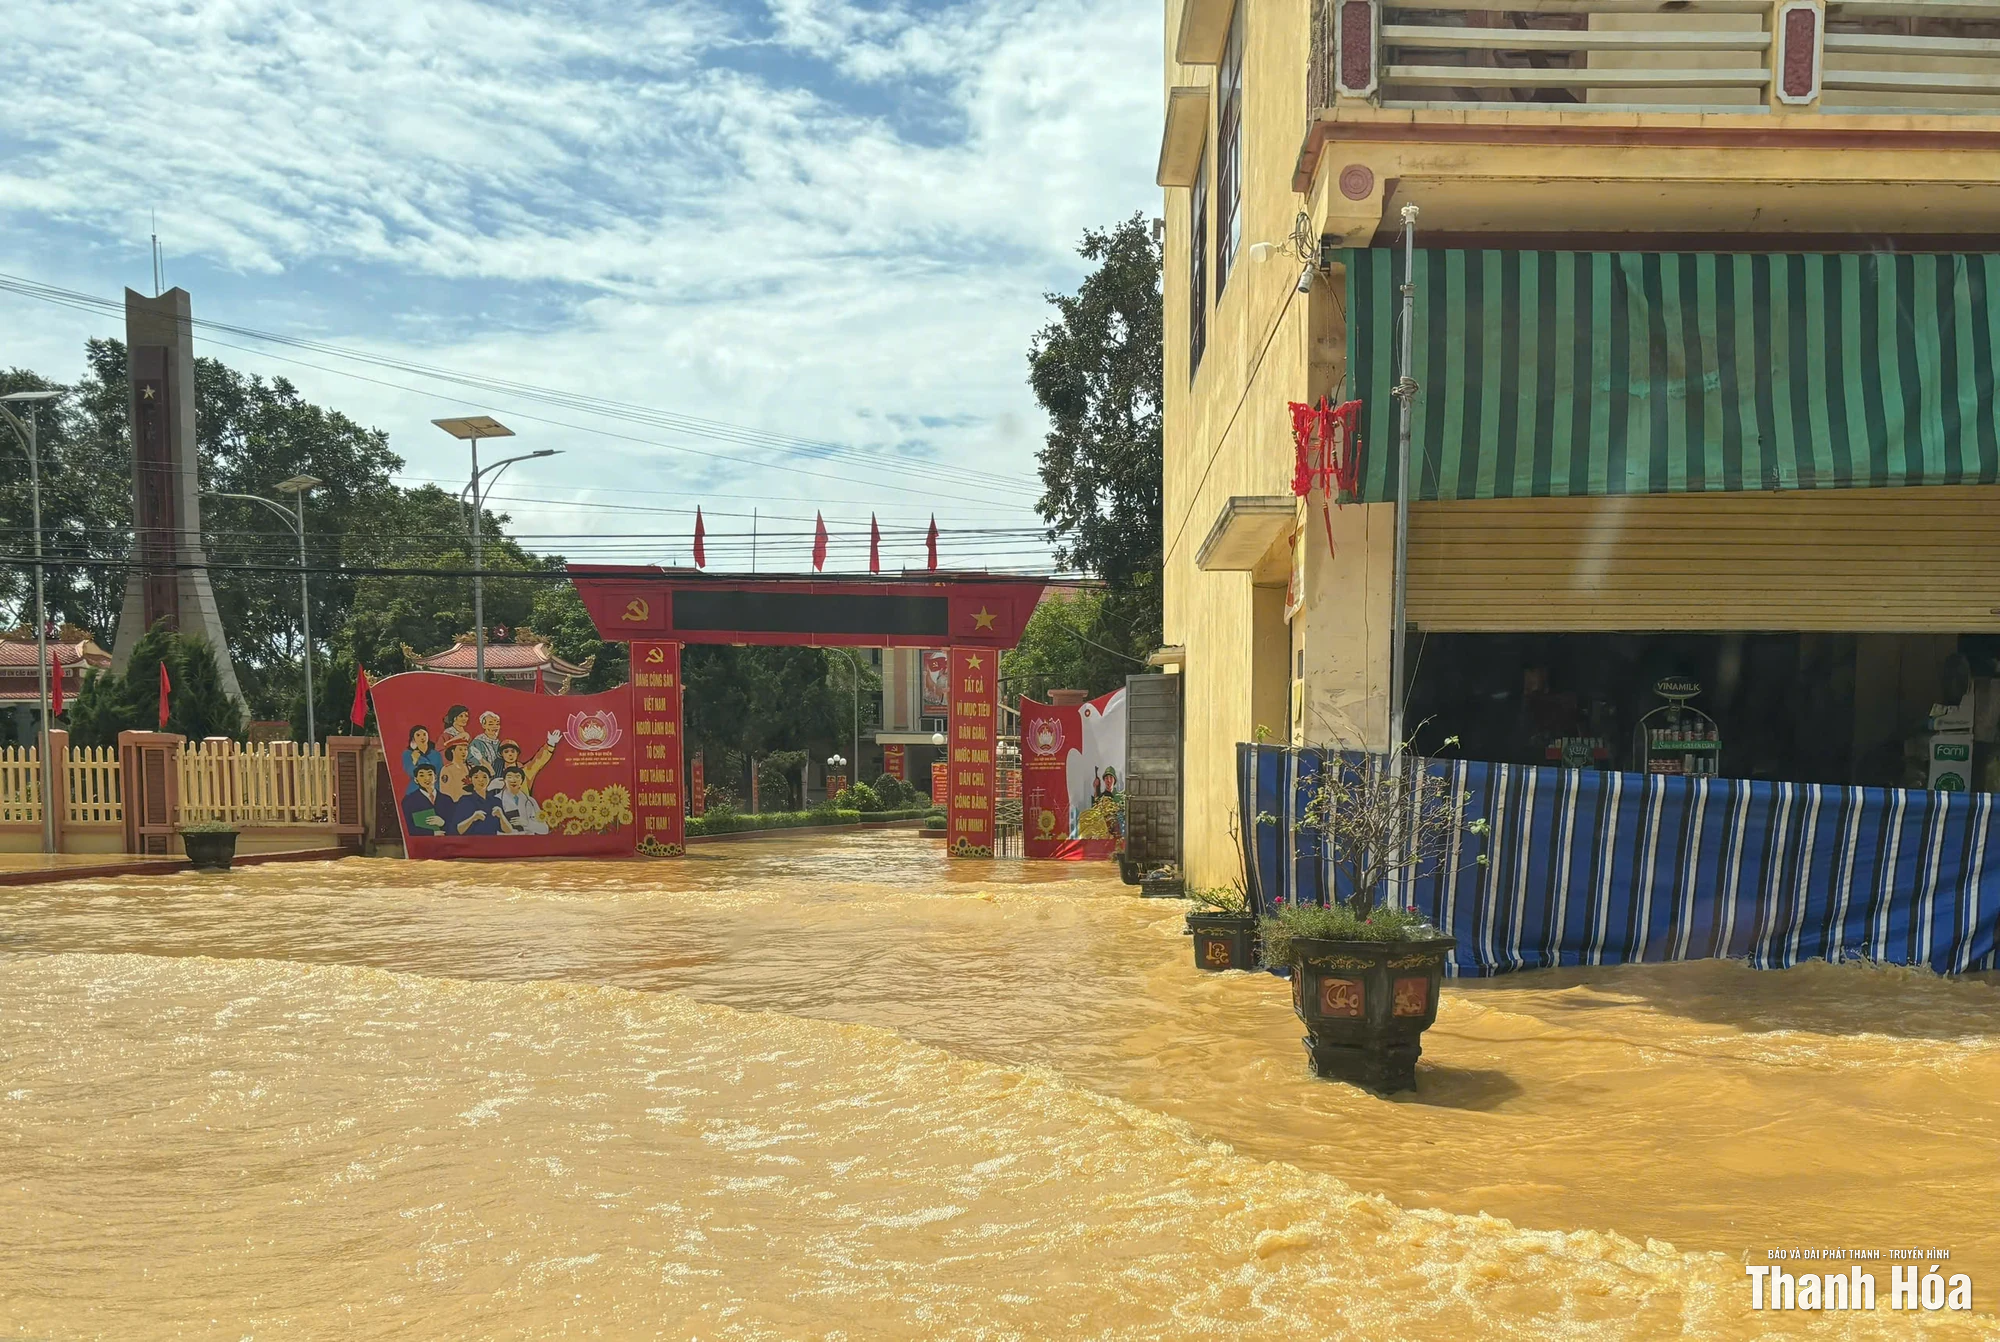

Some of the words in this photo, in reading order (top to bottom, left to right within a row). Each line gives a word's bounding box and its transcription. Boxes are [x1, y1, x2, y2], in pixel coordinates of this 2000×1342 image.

[635, 669, 649, 687] ĐẢNG
[650, 671, 663, 689] CỘNG
[663, 669, 674, 687] SẢN
[964, 675, 974, 693] TẤT
[976, 675, 984, 694] CẢ
[1658, 682, 1700, 690] VINAMILK
[644, 695, 654, 714] VIỆT
[655, 698, 666, 711] NAM
[957, 700, 963, 716] VÌ
[964, 702, 976, 719] MỤC
[978, 700, 990, 717] TIÊU
[636, 718, 651, 735] NGƯỜI
[652, 719, 664, 735] LÃNH
[958, 723, 971, 740] DÂN
[972, 724, 987, 742] GIÀU,
[653, 742, 666, 759] CHỨC
[955, 746, 970, 762] NƯỚC
[640, 769, 649, 786] MỌI
[650, 764, 665, 782] THẮNG
[666, 768, 674, 786] LỢI
[958, 770, 971, 786] DÂN
[638, 788, 648, 806] CỦA
[649, 790, 661, 806] CÁCH
[662, 792, 676, 809] MẠNG
[955, 792, 970, 808] CÔNG
[645, 814, 655, 833] VIỆT
[656, 816, 668, 830] NAM
[956, 816, 967, 832] VĂN
[968, 818, 983, 832] MINH
